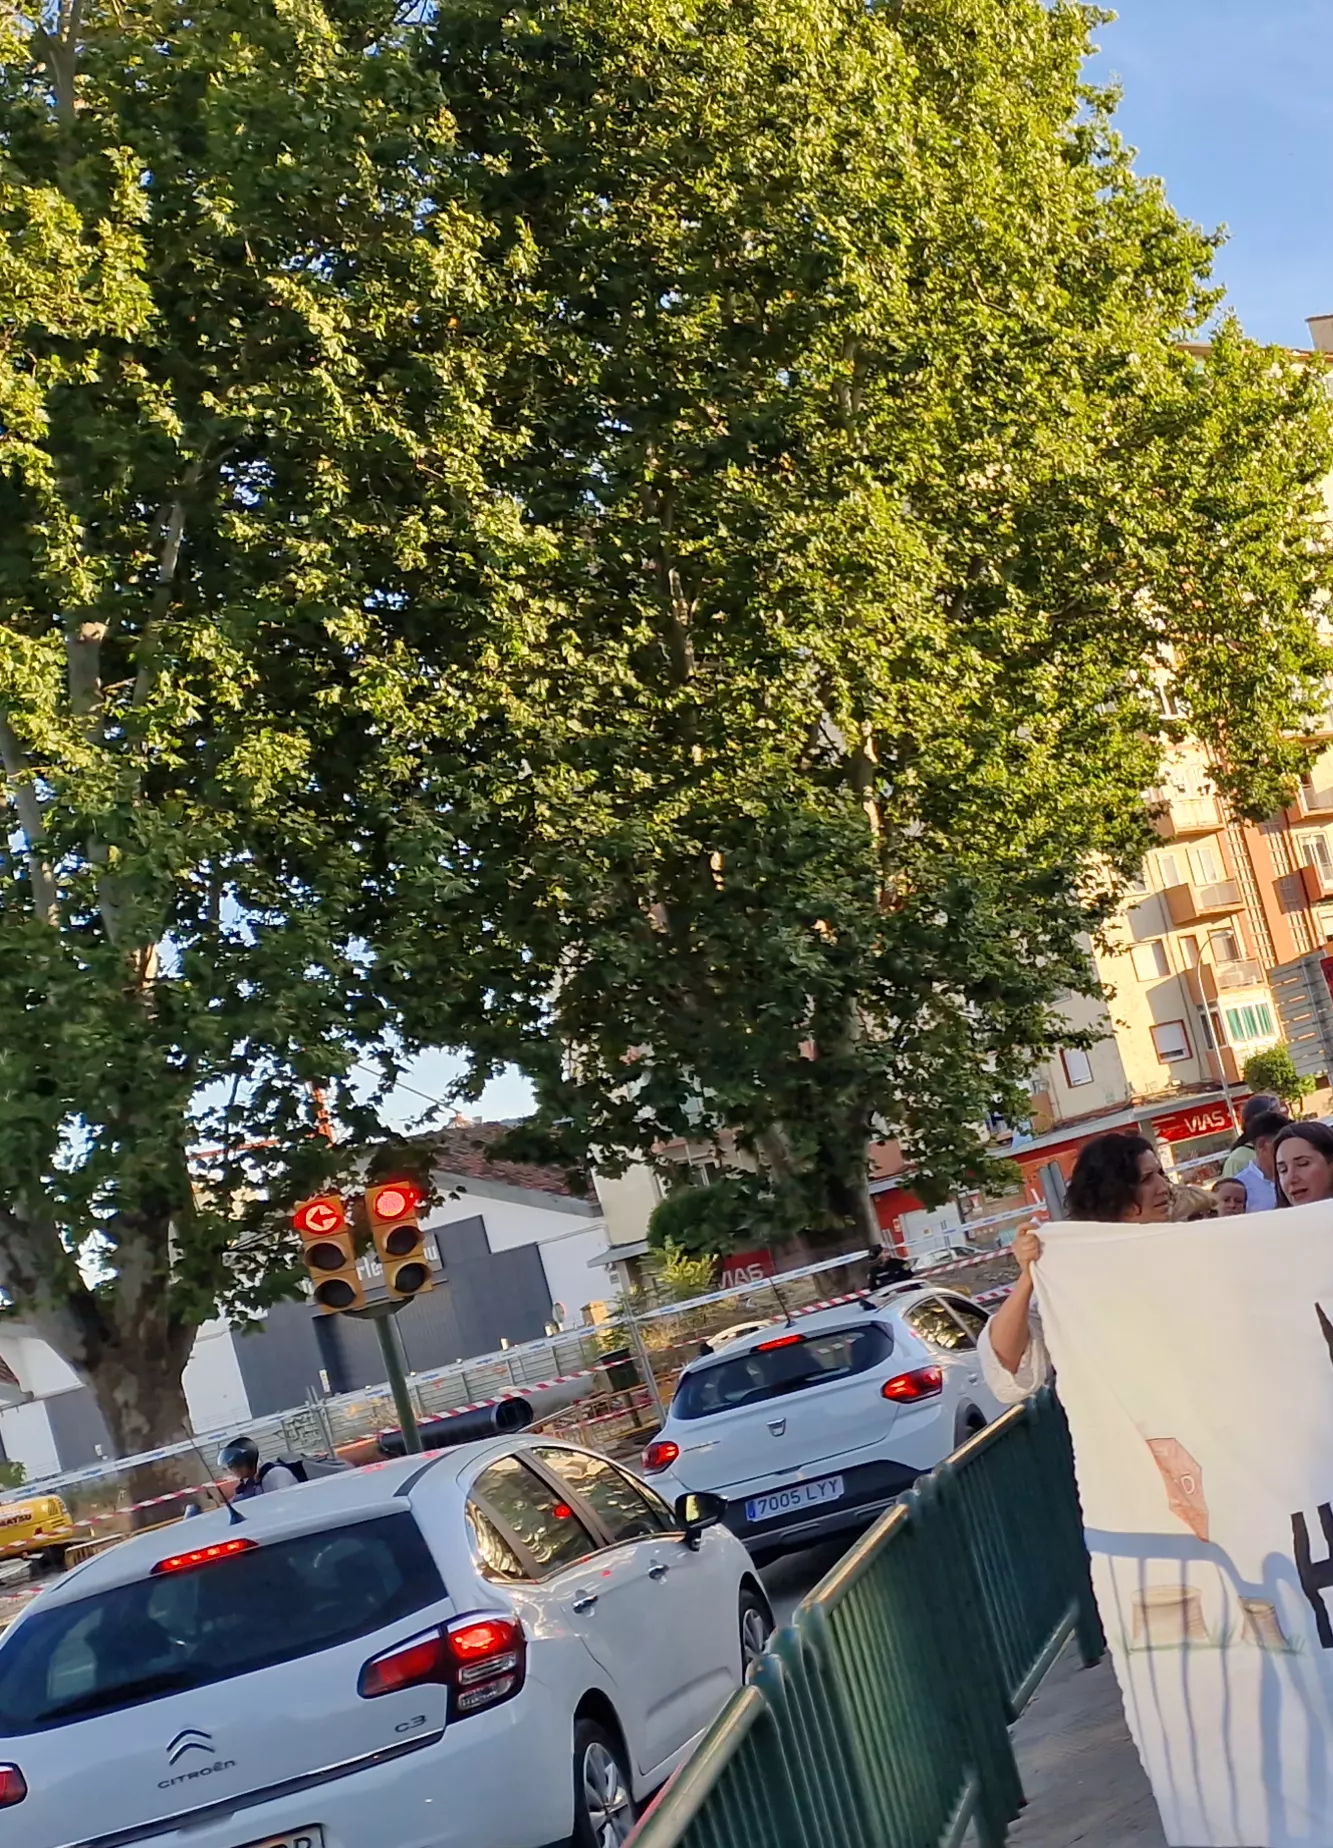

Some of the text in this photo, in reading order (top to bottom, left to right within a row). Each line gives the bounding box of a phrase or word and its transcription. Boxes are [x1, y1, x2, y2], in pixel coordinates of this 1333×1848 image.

[1184, 1110, 1225, 1133] VIAS
[757, 1478, 838, 1515] 7005 LYY
[394, 1714, 426, 1734] C3
